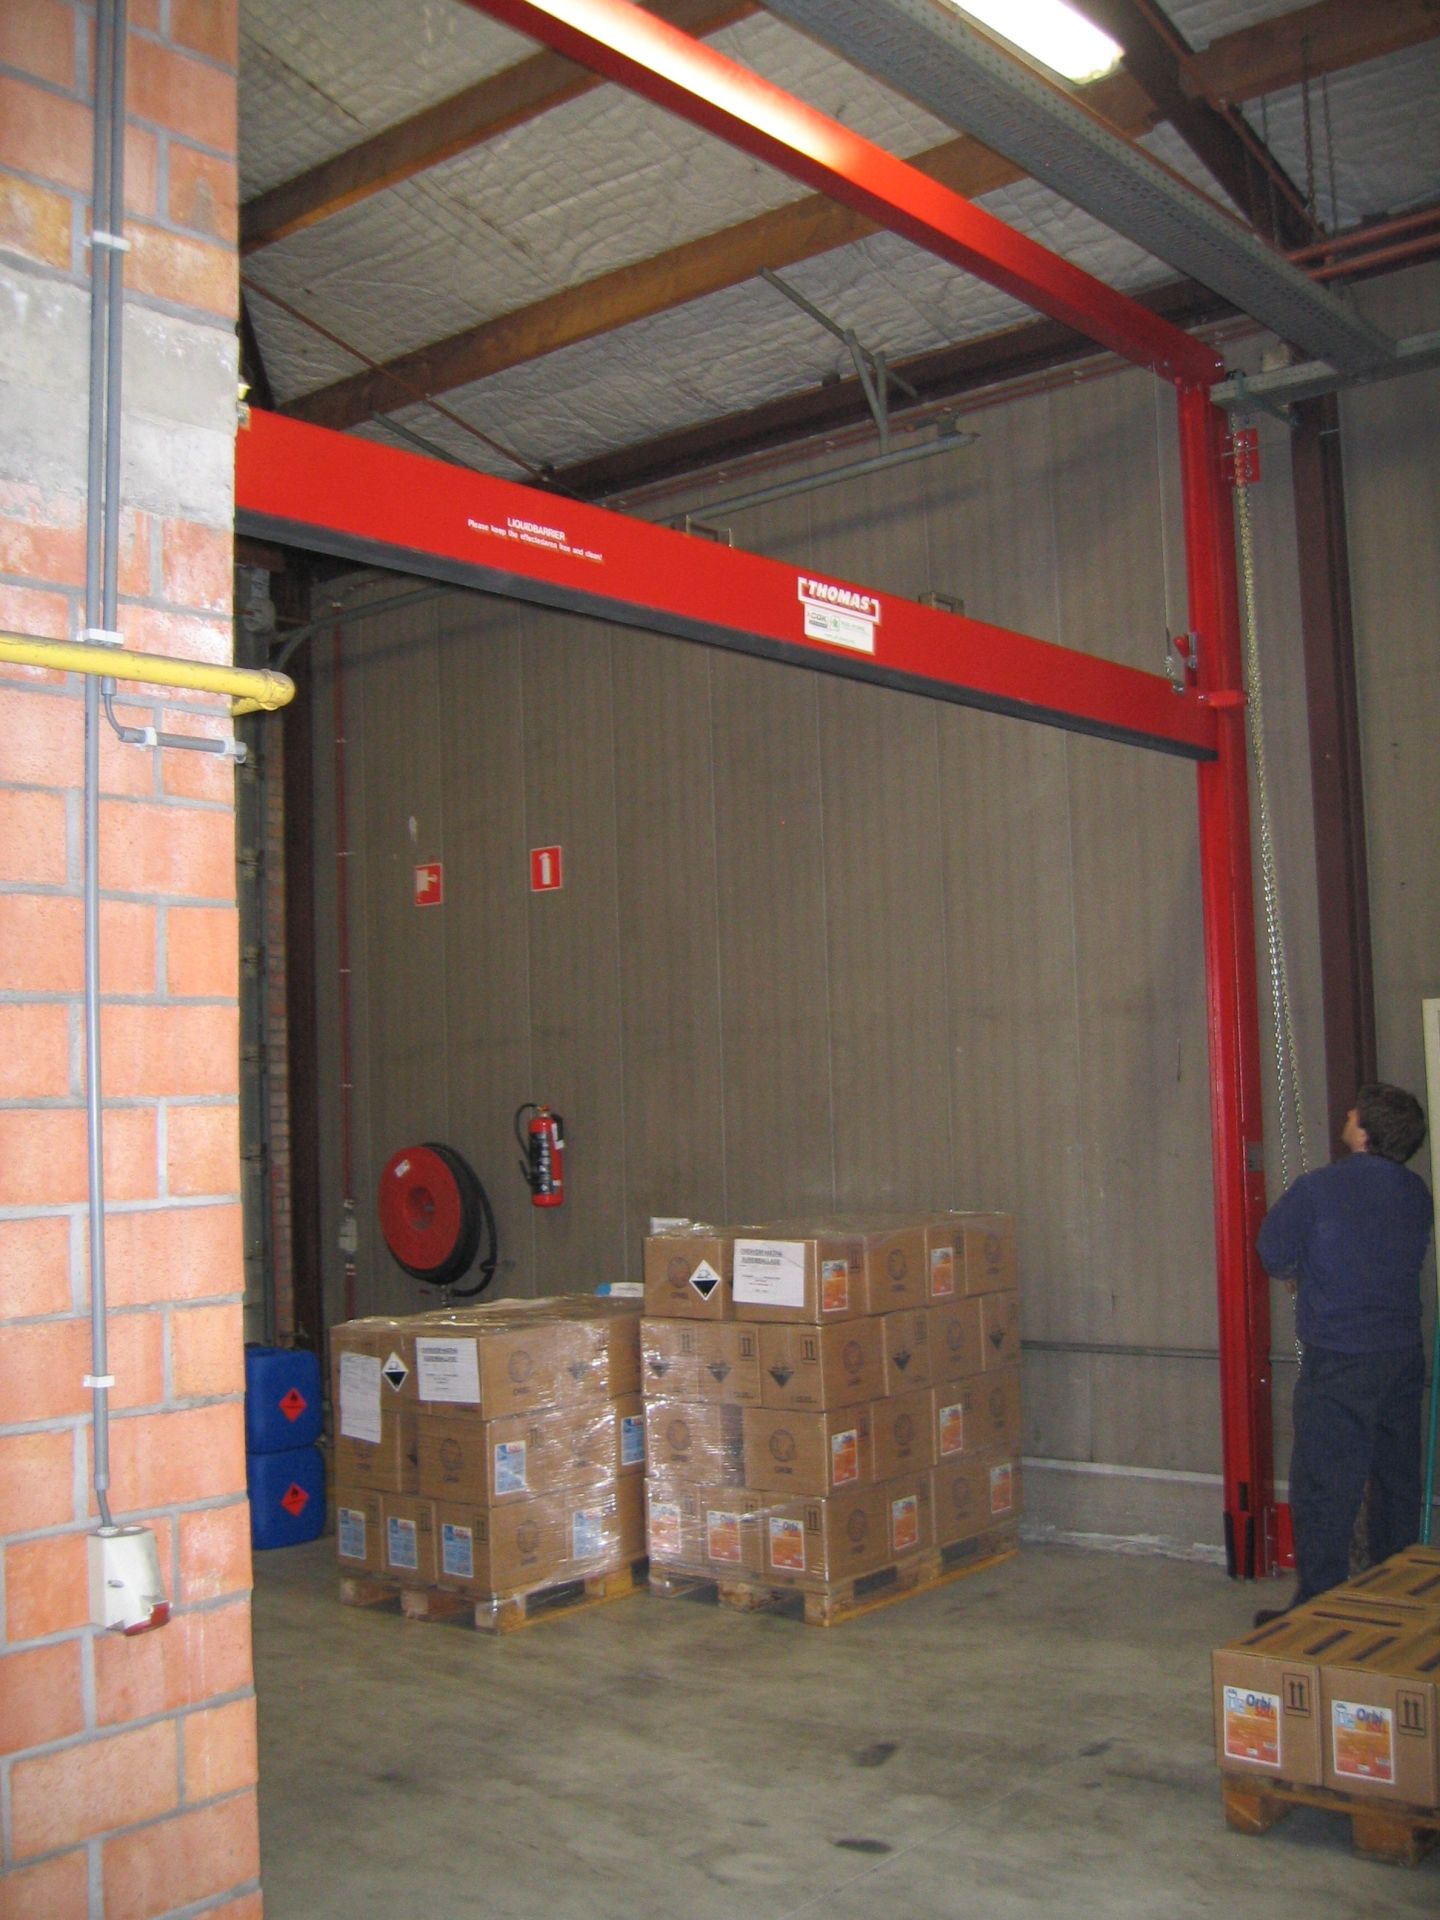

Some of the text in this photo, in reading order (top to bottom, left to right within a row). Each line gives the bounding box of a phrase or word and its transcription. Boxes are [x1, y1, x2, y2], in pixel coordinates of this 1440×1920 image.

[468, 518, 489, 531] Please
[491, 524, 507, 537] keep
[508, 530, 519, 539] the
[572, 547, 584, 556] and
[507, 517, 565, 541] LIQUIDBARRIER
[808, 579, 870, 612] THOMAS
